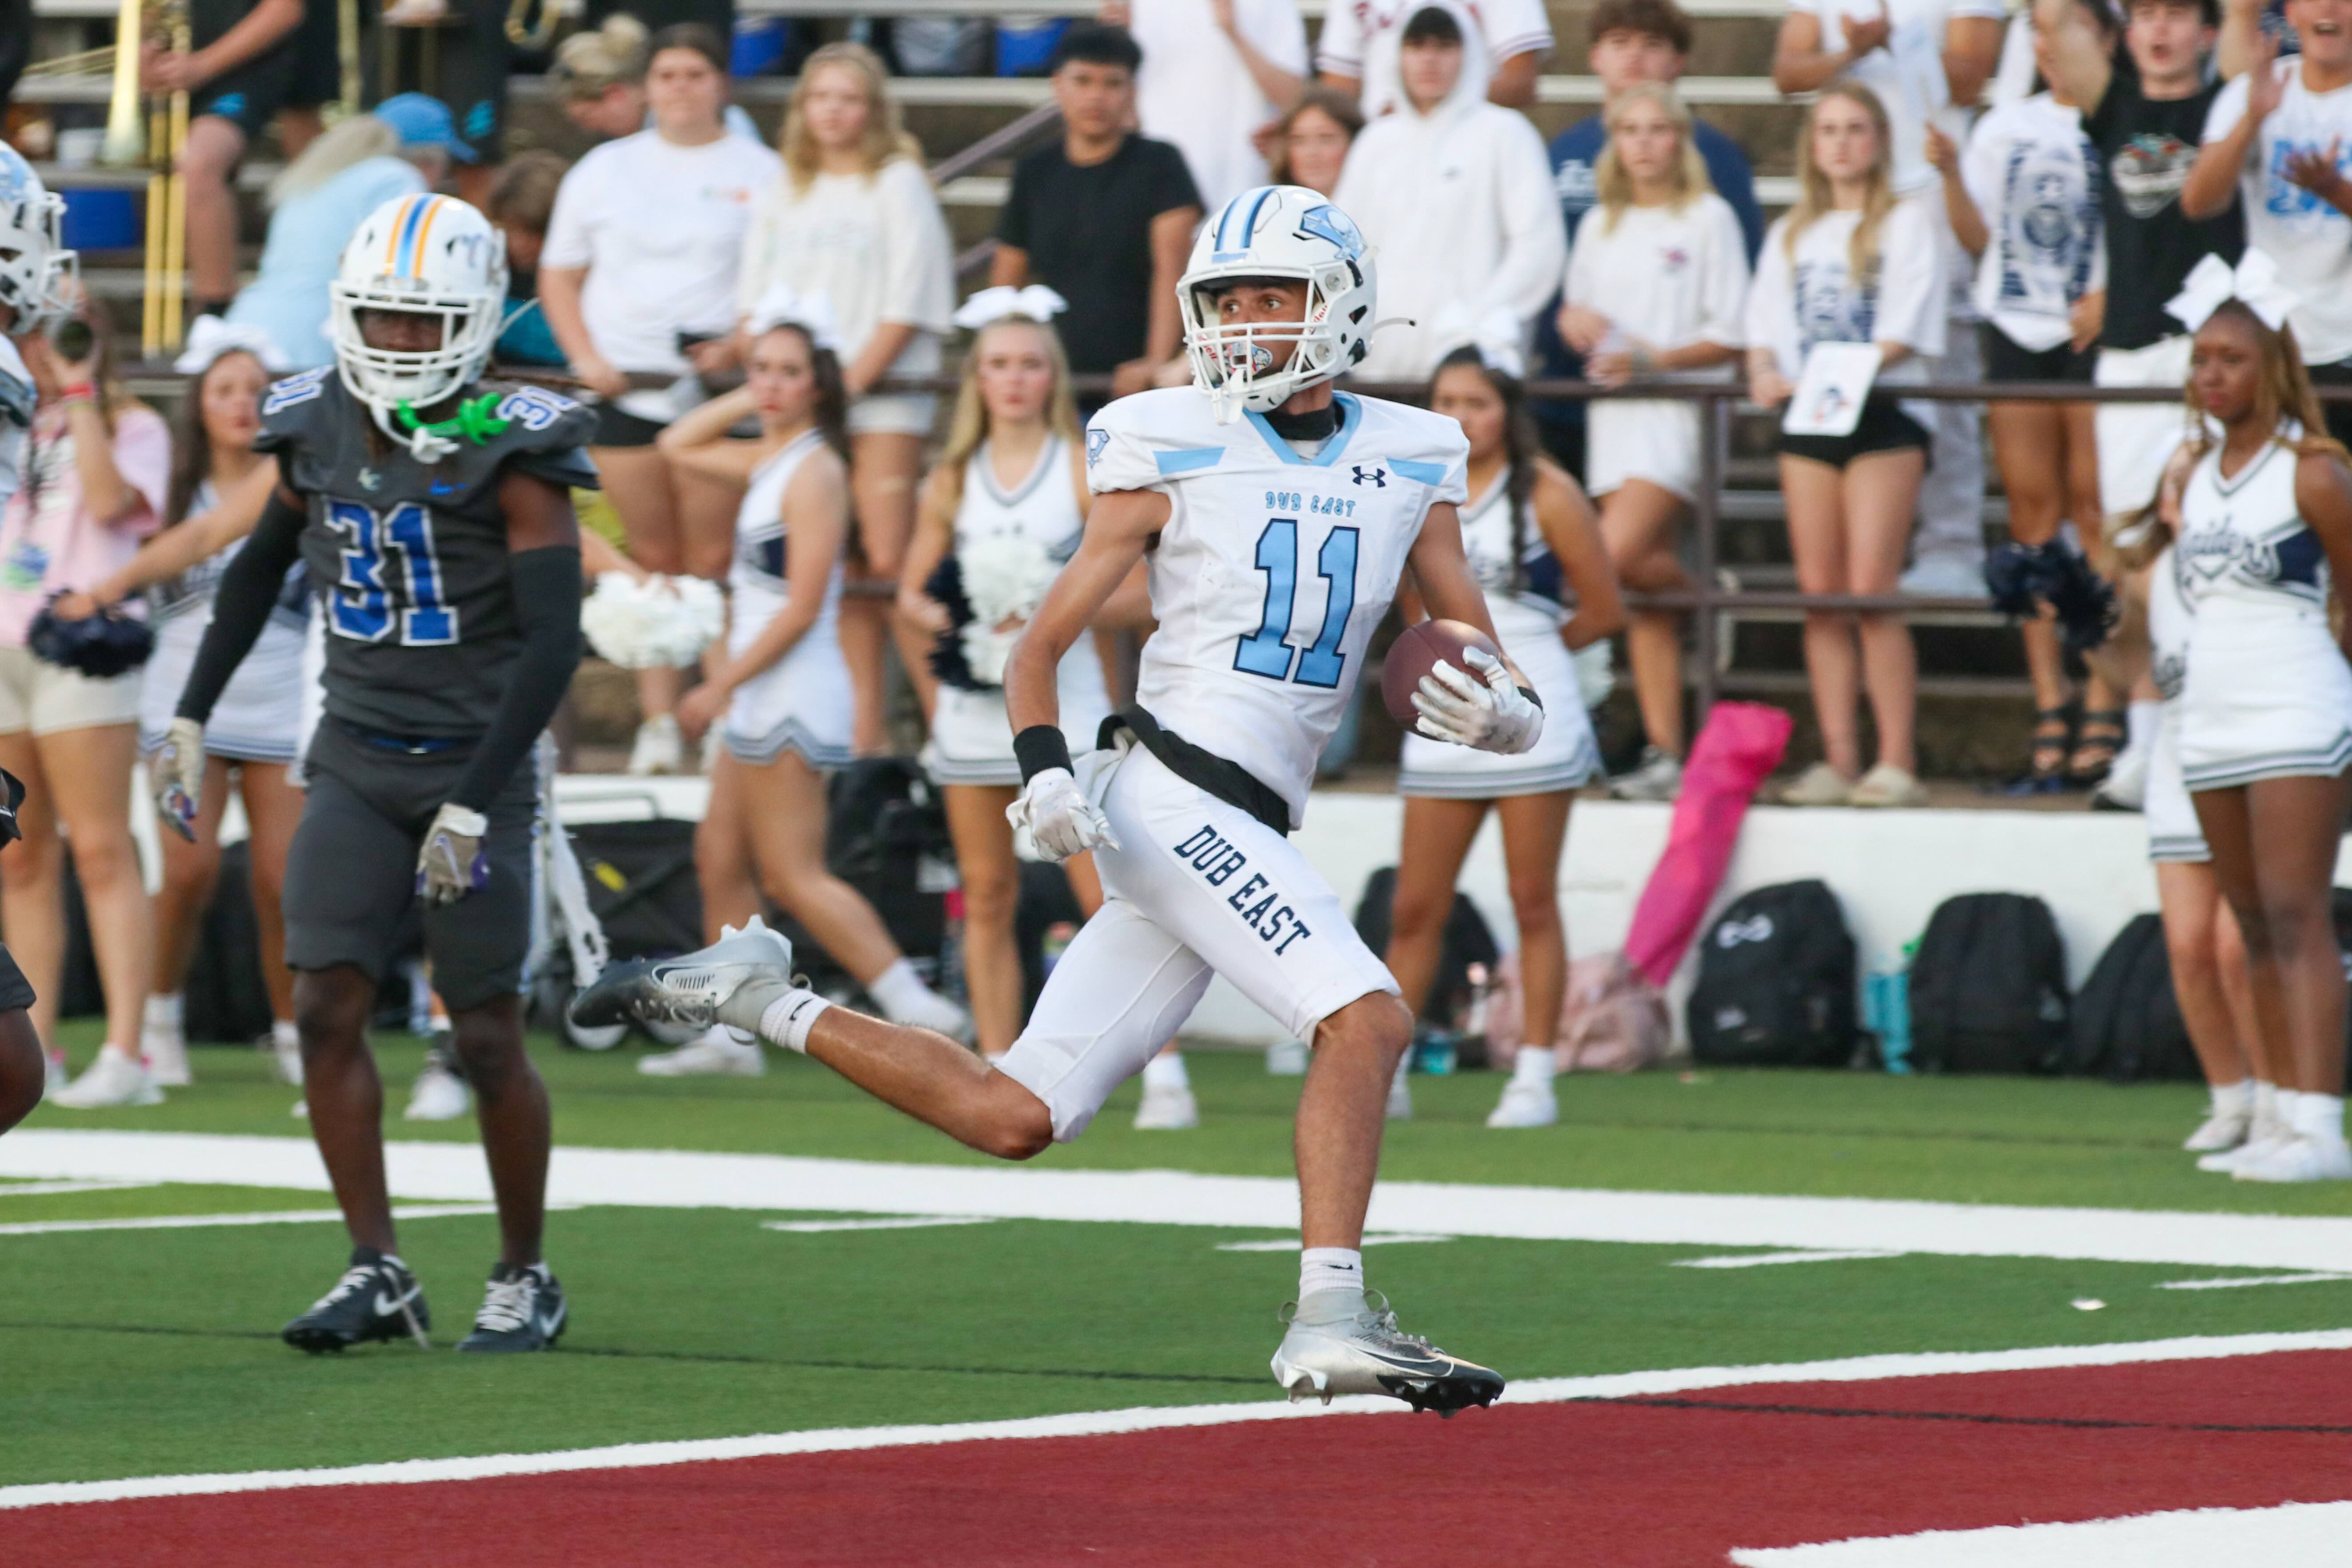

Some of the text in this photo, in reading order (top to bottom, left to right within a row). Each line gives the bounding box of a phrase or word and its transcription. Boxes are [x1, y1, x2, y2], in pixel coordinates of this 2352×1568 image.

[320, 494, 461, 646] 31
[1265, 491, 1356, 518] DUB EAST
[1232, 518, 1360, 689] 11
[1173, 824, 1312, 956] DUB EAST
